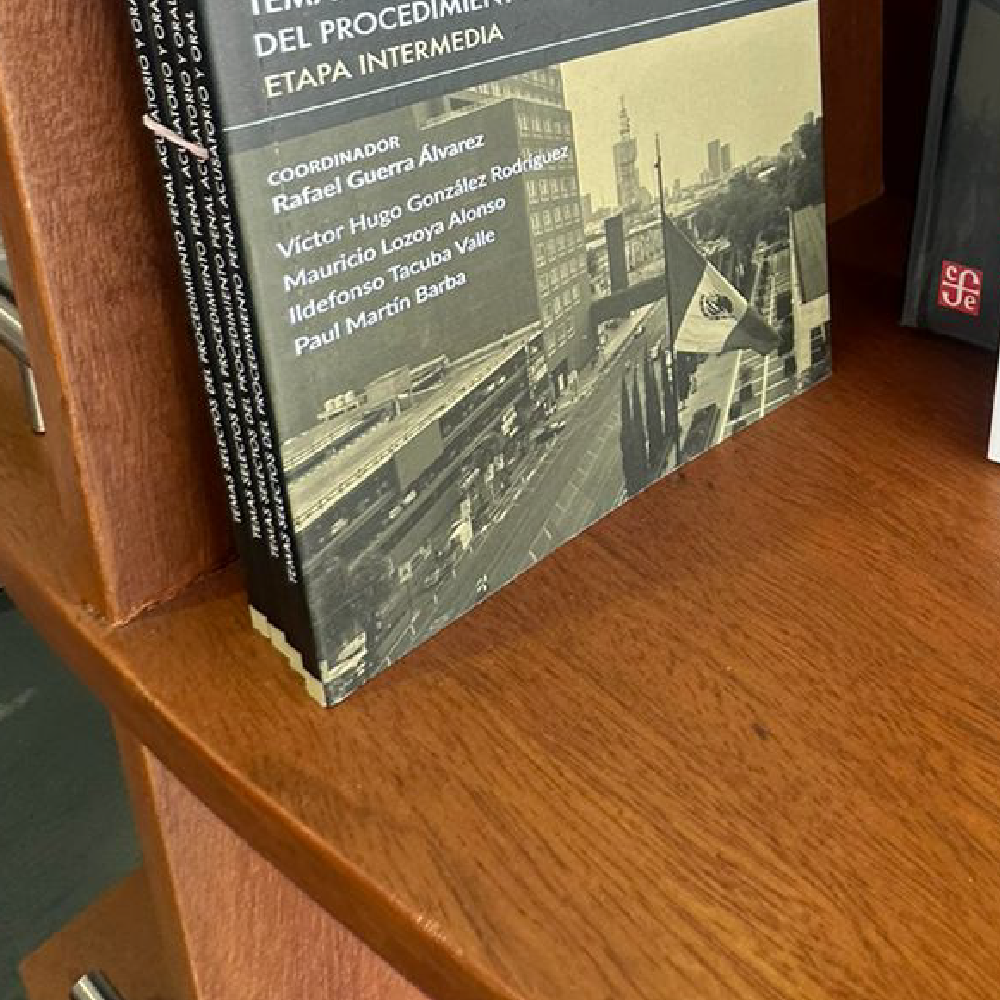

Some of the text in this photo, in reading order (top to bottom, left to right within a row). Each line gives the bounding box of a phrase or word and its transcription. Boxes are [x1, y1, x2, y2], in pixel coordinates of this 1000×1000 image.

[254, 25, 313, 57] DEL
[264, 22, 505, 99] ETAPA INTERMEDIA
[266, 134, 401, 187] COORDINADOR
[271, 133, 486, 214] Rafael Guerra Álvarez
[276, 144, 570, 259] Víctor Hugo González Rodríguez
[283, 196, 507, 293] Mauricio Lozoya Alonso
[288, 228, 496, 325] Ildefonso Tacuba Valle
[294, 271, 467, 356] Paul Martín Barba
